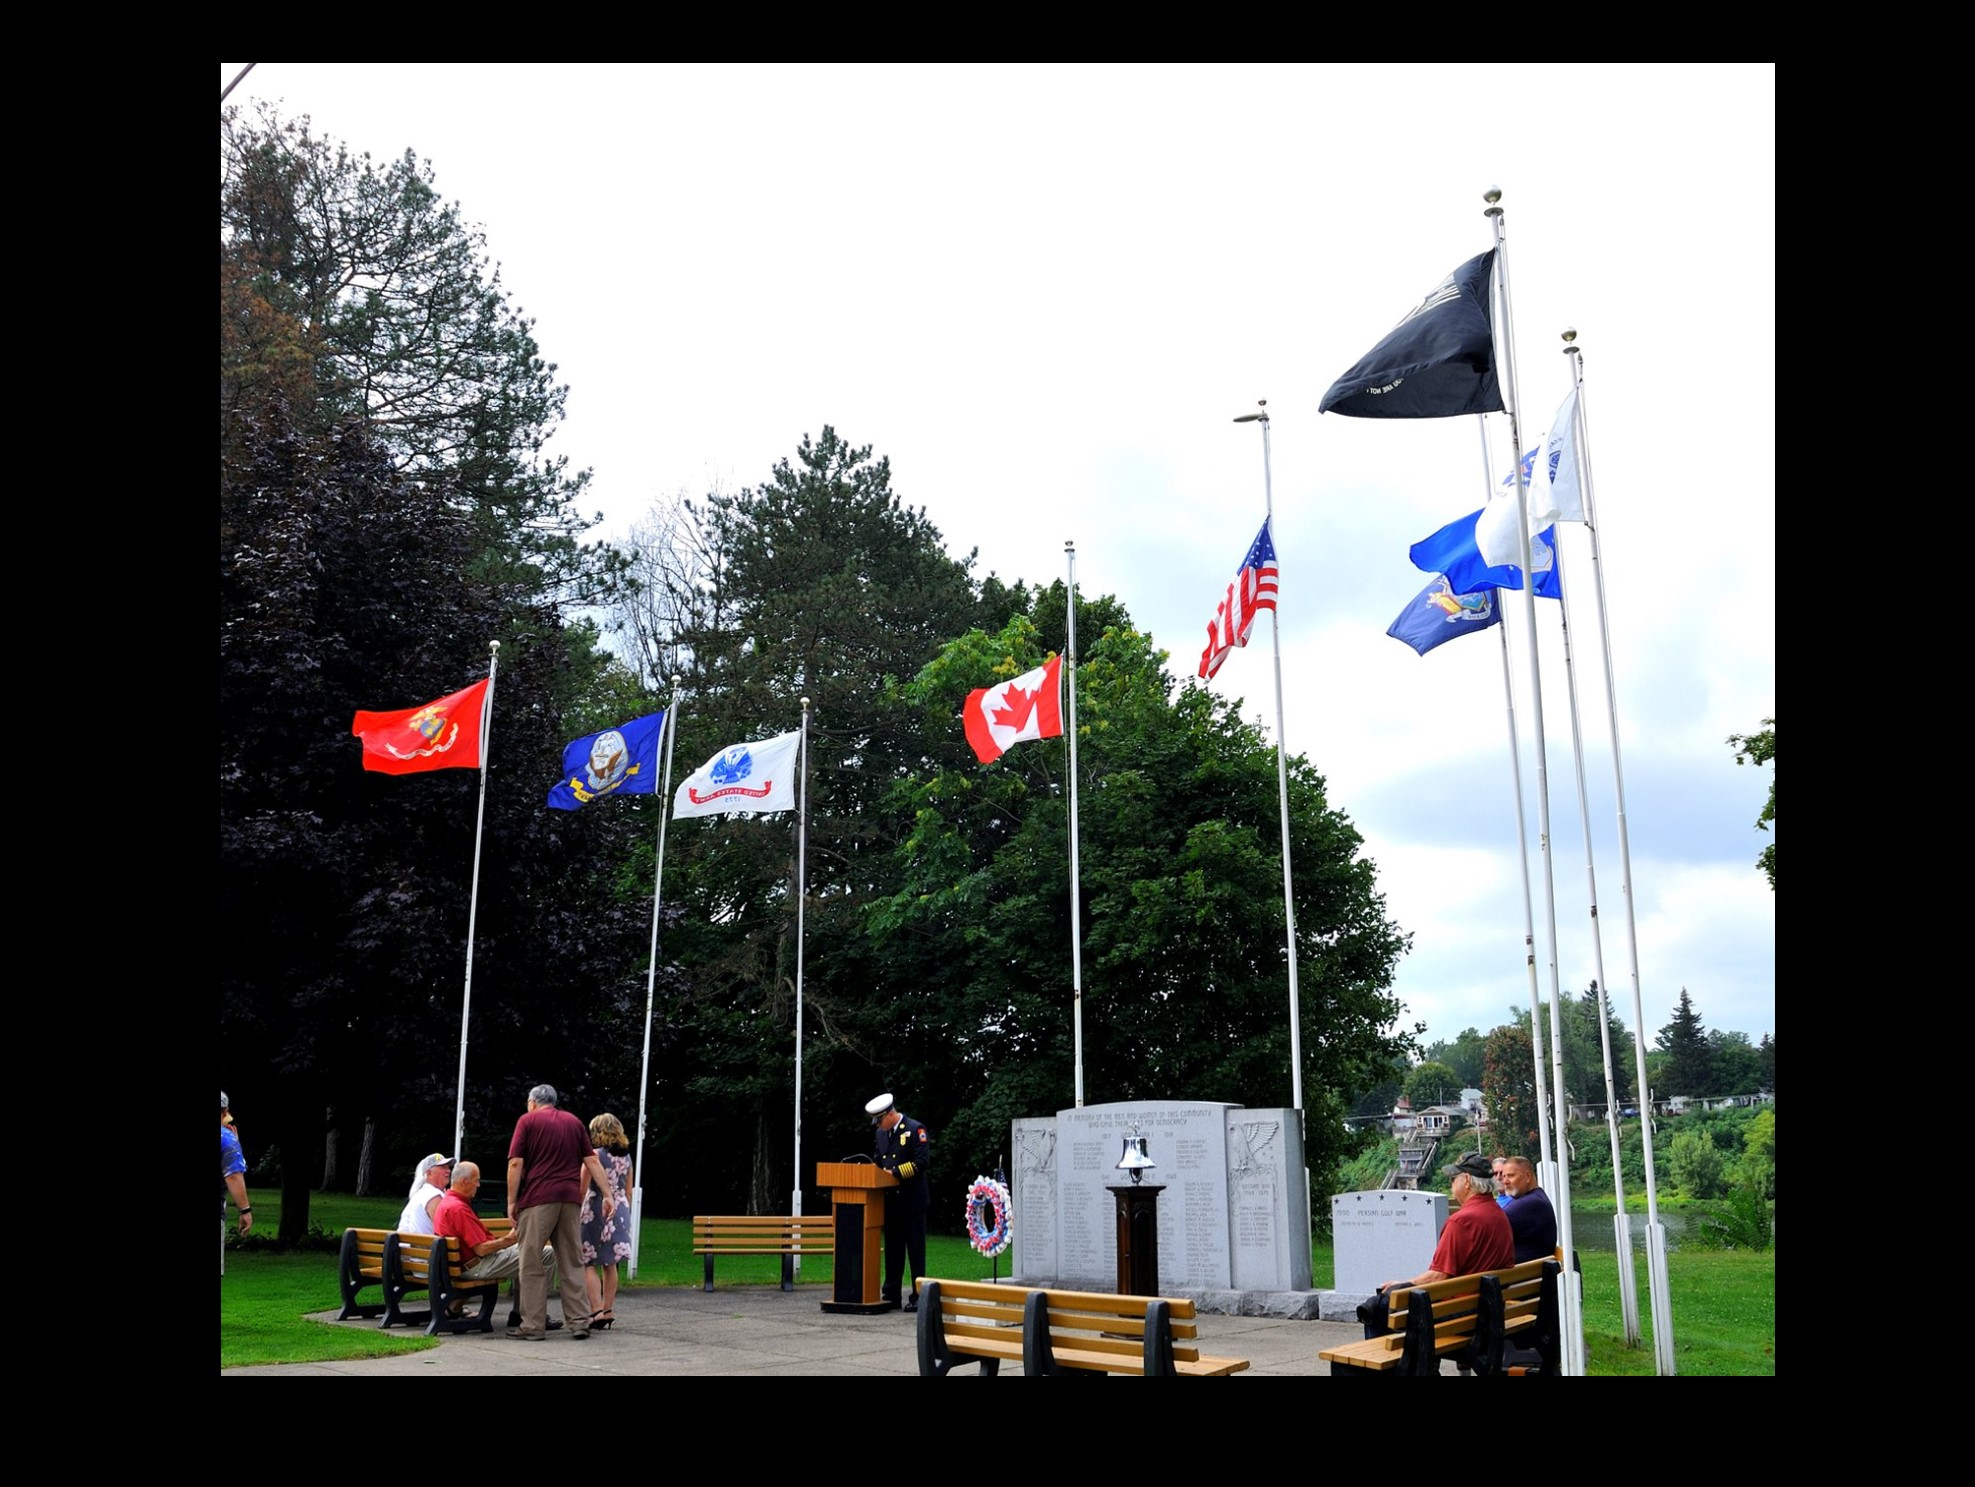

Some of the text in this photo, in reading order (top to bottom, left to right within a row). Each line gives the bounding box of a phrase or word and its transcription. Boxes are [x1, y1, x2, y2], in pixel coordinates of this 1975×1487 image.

[1103, 1112, 1112, 1120] THE
[1168, 1110, 1178, 1118] THIS
[1180, 1109, 1212, 1118] COMMUNITY
[1156, 1118, 1187, 1127] DEMOCRACY
[1357, 1209, 1379, 1217] PERSIAN
